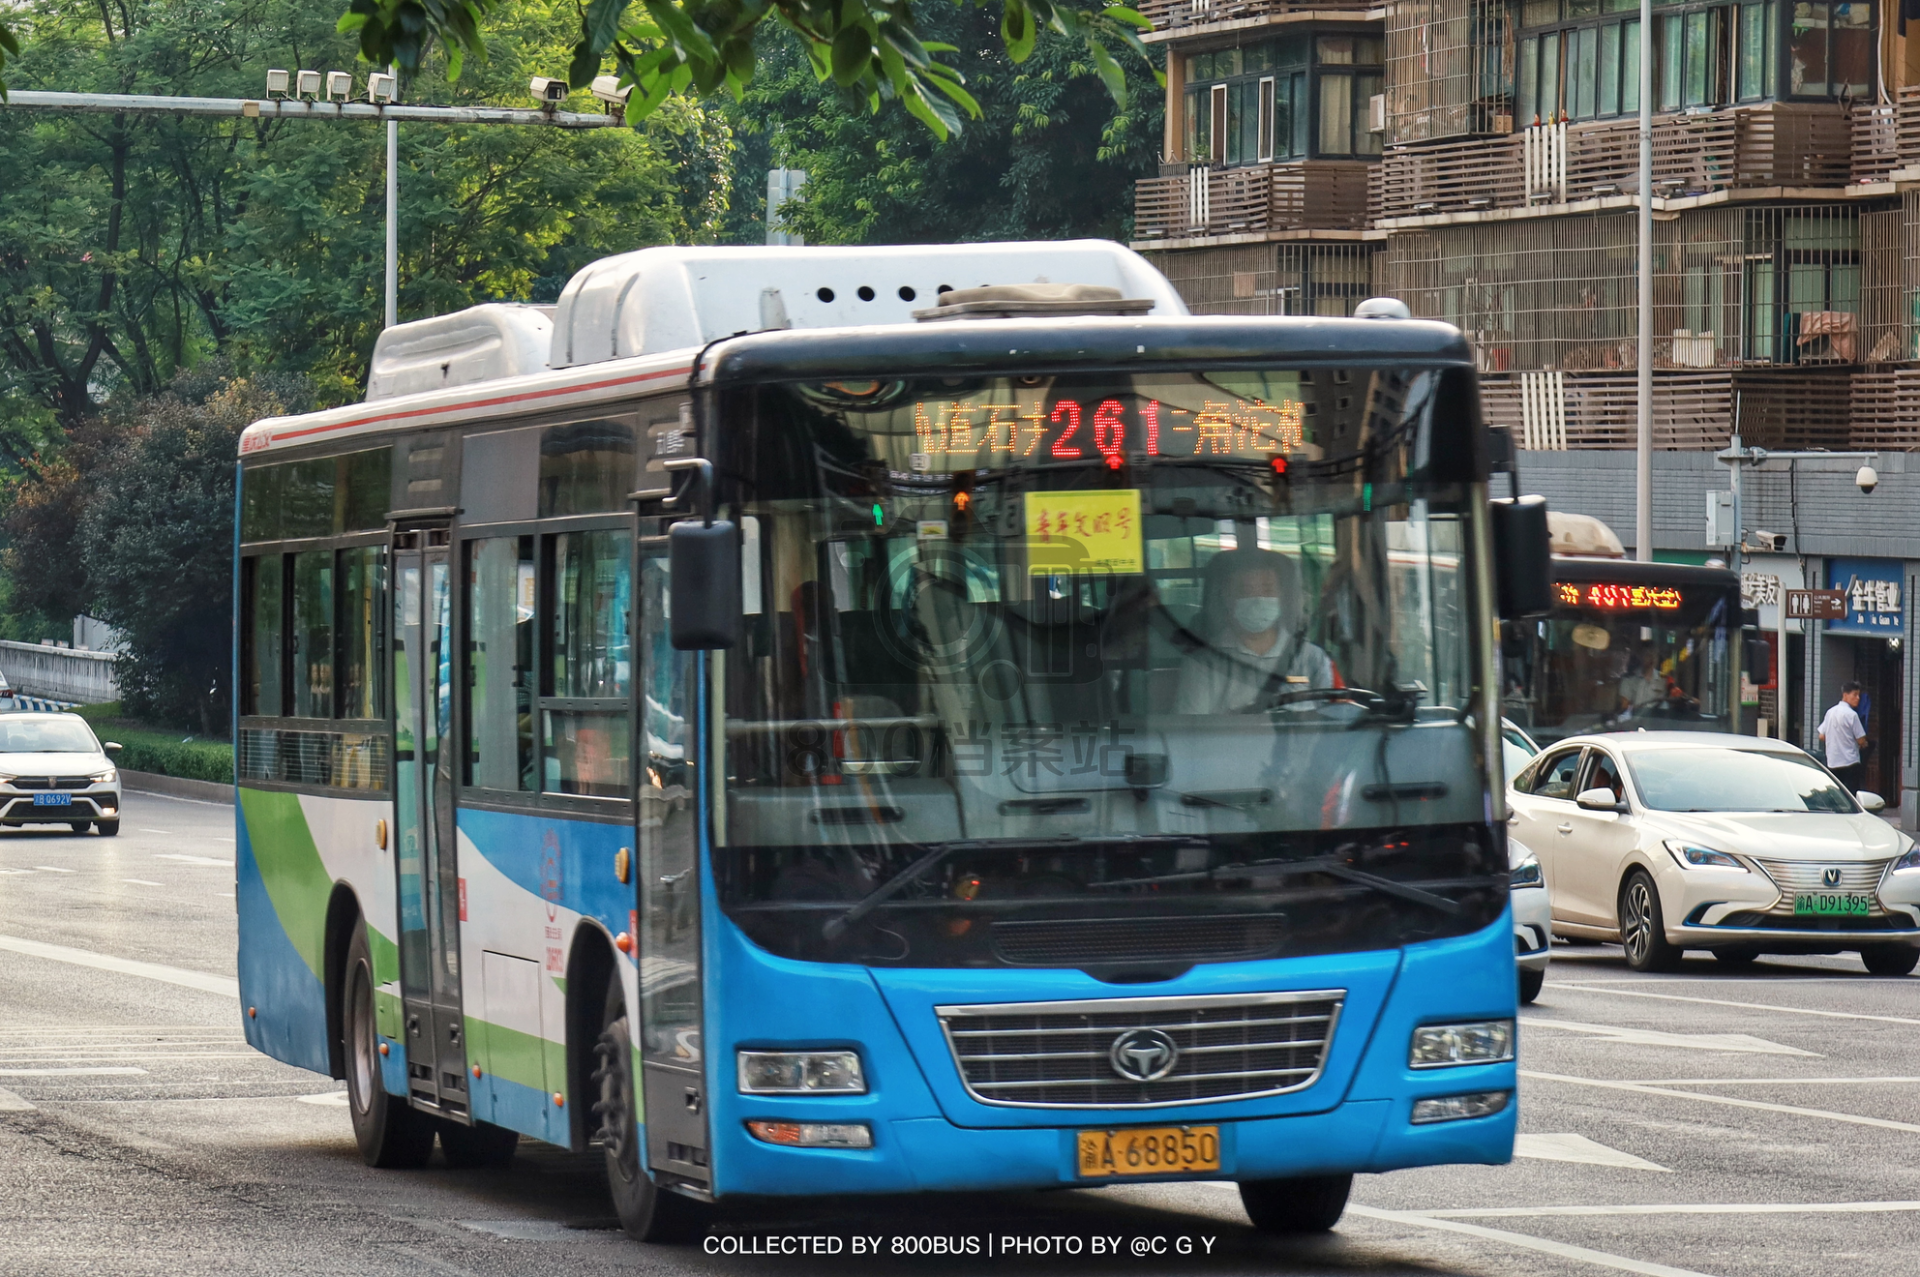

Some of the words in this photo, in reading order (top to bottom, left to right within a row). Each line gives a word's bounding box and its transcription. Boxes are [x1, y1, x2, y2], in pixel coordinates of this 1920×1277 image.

[1051, 400, 1159, 456] 261
[1851, 579, 1902, 613] 金牛管业
